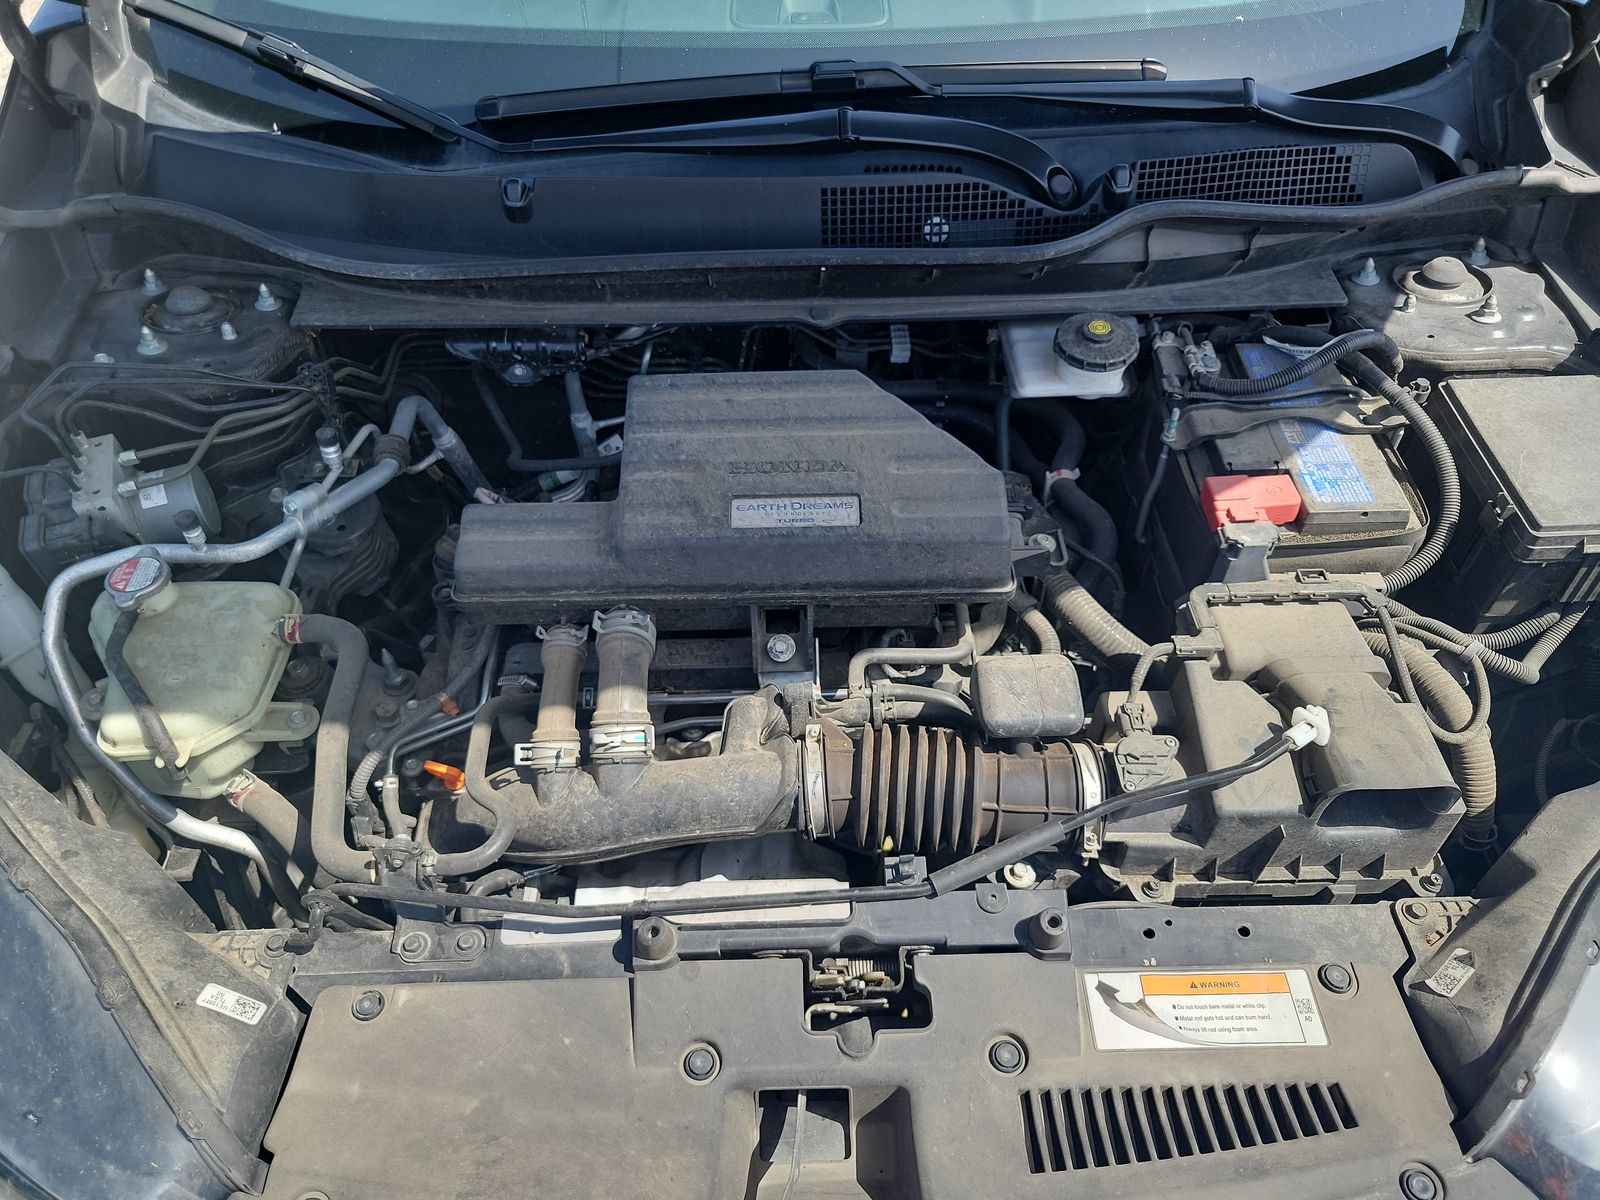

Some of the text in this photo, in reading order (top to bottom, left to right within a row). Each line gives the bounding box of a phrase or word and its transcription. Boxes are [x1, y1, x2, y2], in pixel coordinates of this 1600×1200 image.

[728, 459, 857, 475] HONDA
[736, 501, 854, 512] EARTH DREAMS
[1199, 981, 1240, 989] WARNING
